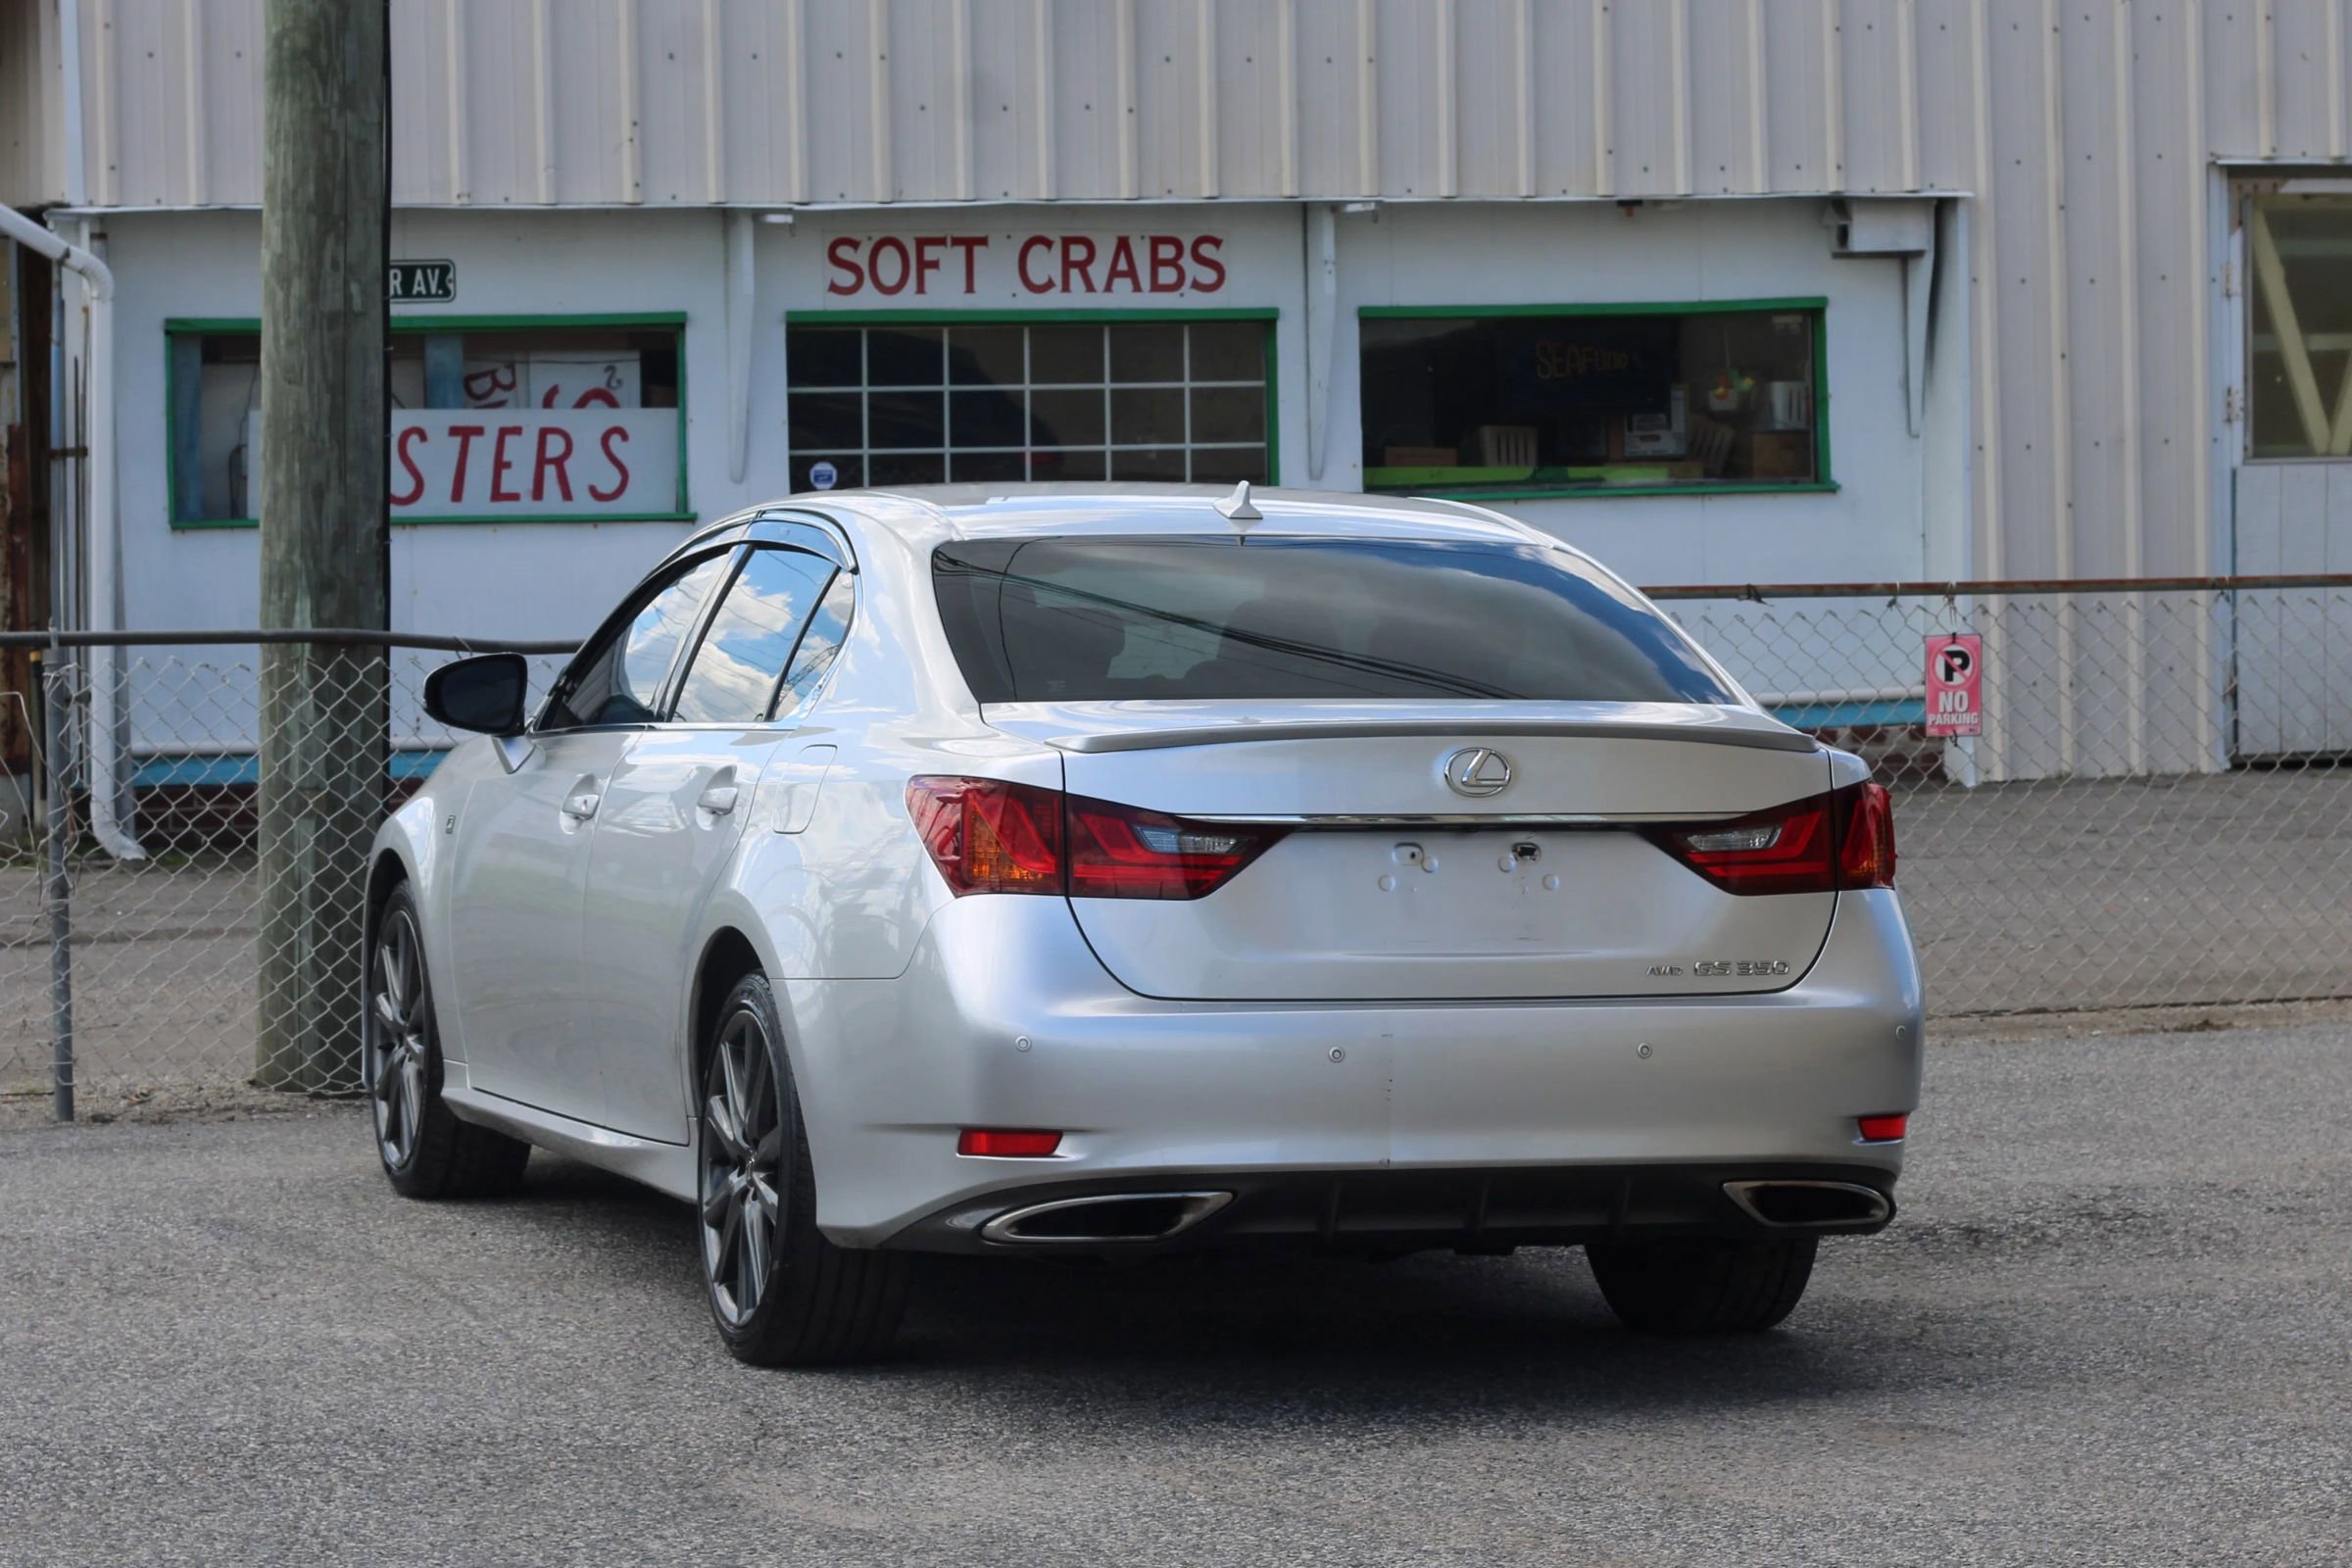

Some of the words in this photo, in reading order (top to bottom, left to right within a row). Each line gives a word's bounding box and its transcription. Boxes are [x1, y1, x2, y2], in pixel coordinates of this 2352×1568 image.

[826, 234, 989, 296] SOFT
[1017, 234, 1227, 294] CRABS
[412, 268, 443, 295] AV.
[389, 425, 629, 507] STERS
[1938, 689, 1969, 713] NO
[1928, 712, 1979, 725] PARKING
[1646, 964, 1684, 977] AWD
[1694, 961, 1732, 977] GS
[1737, 960, 1790, 976] 350
